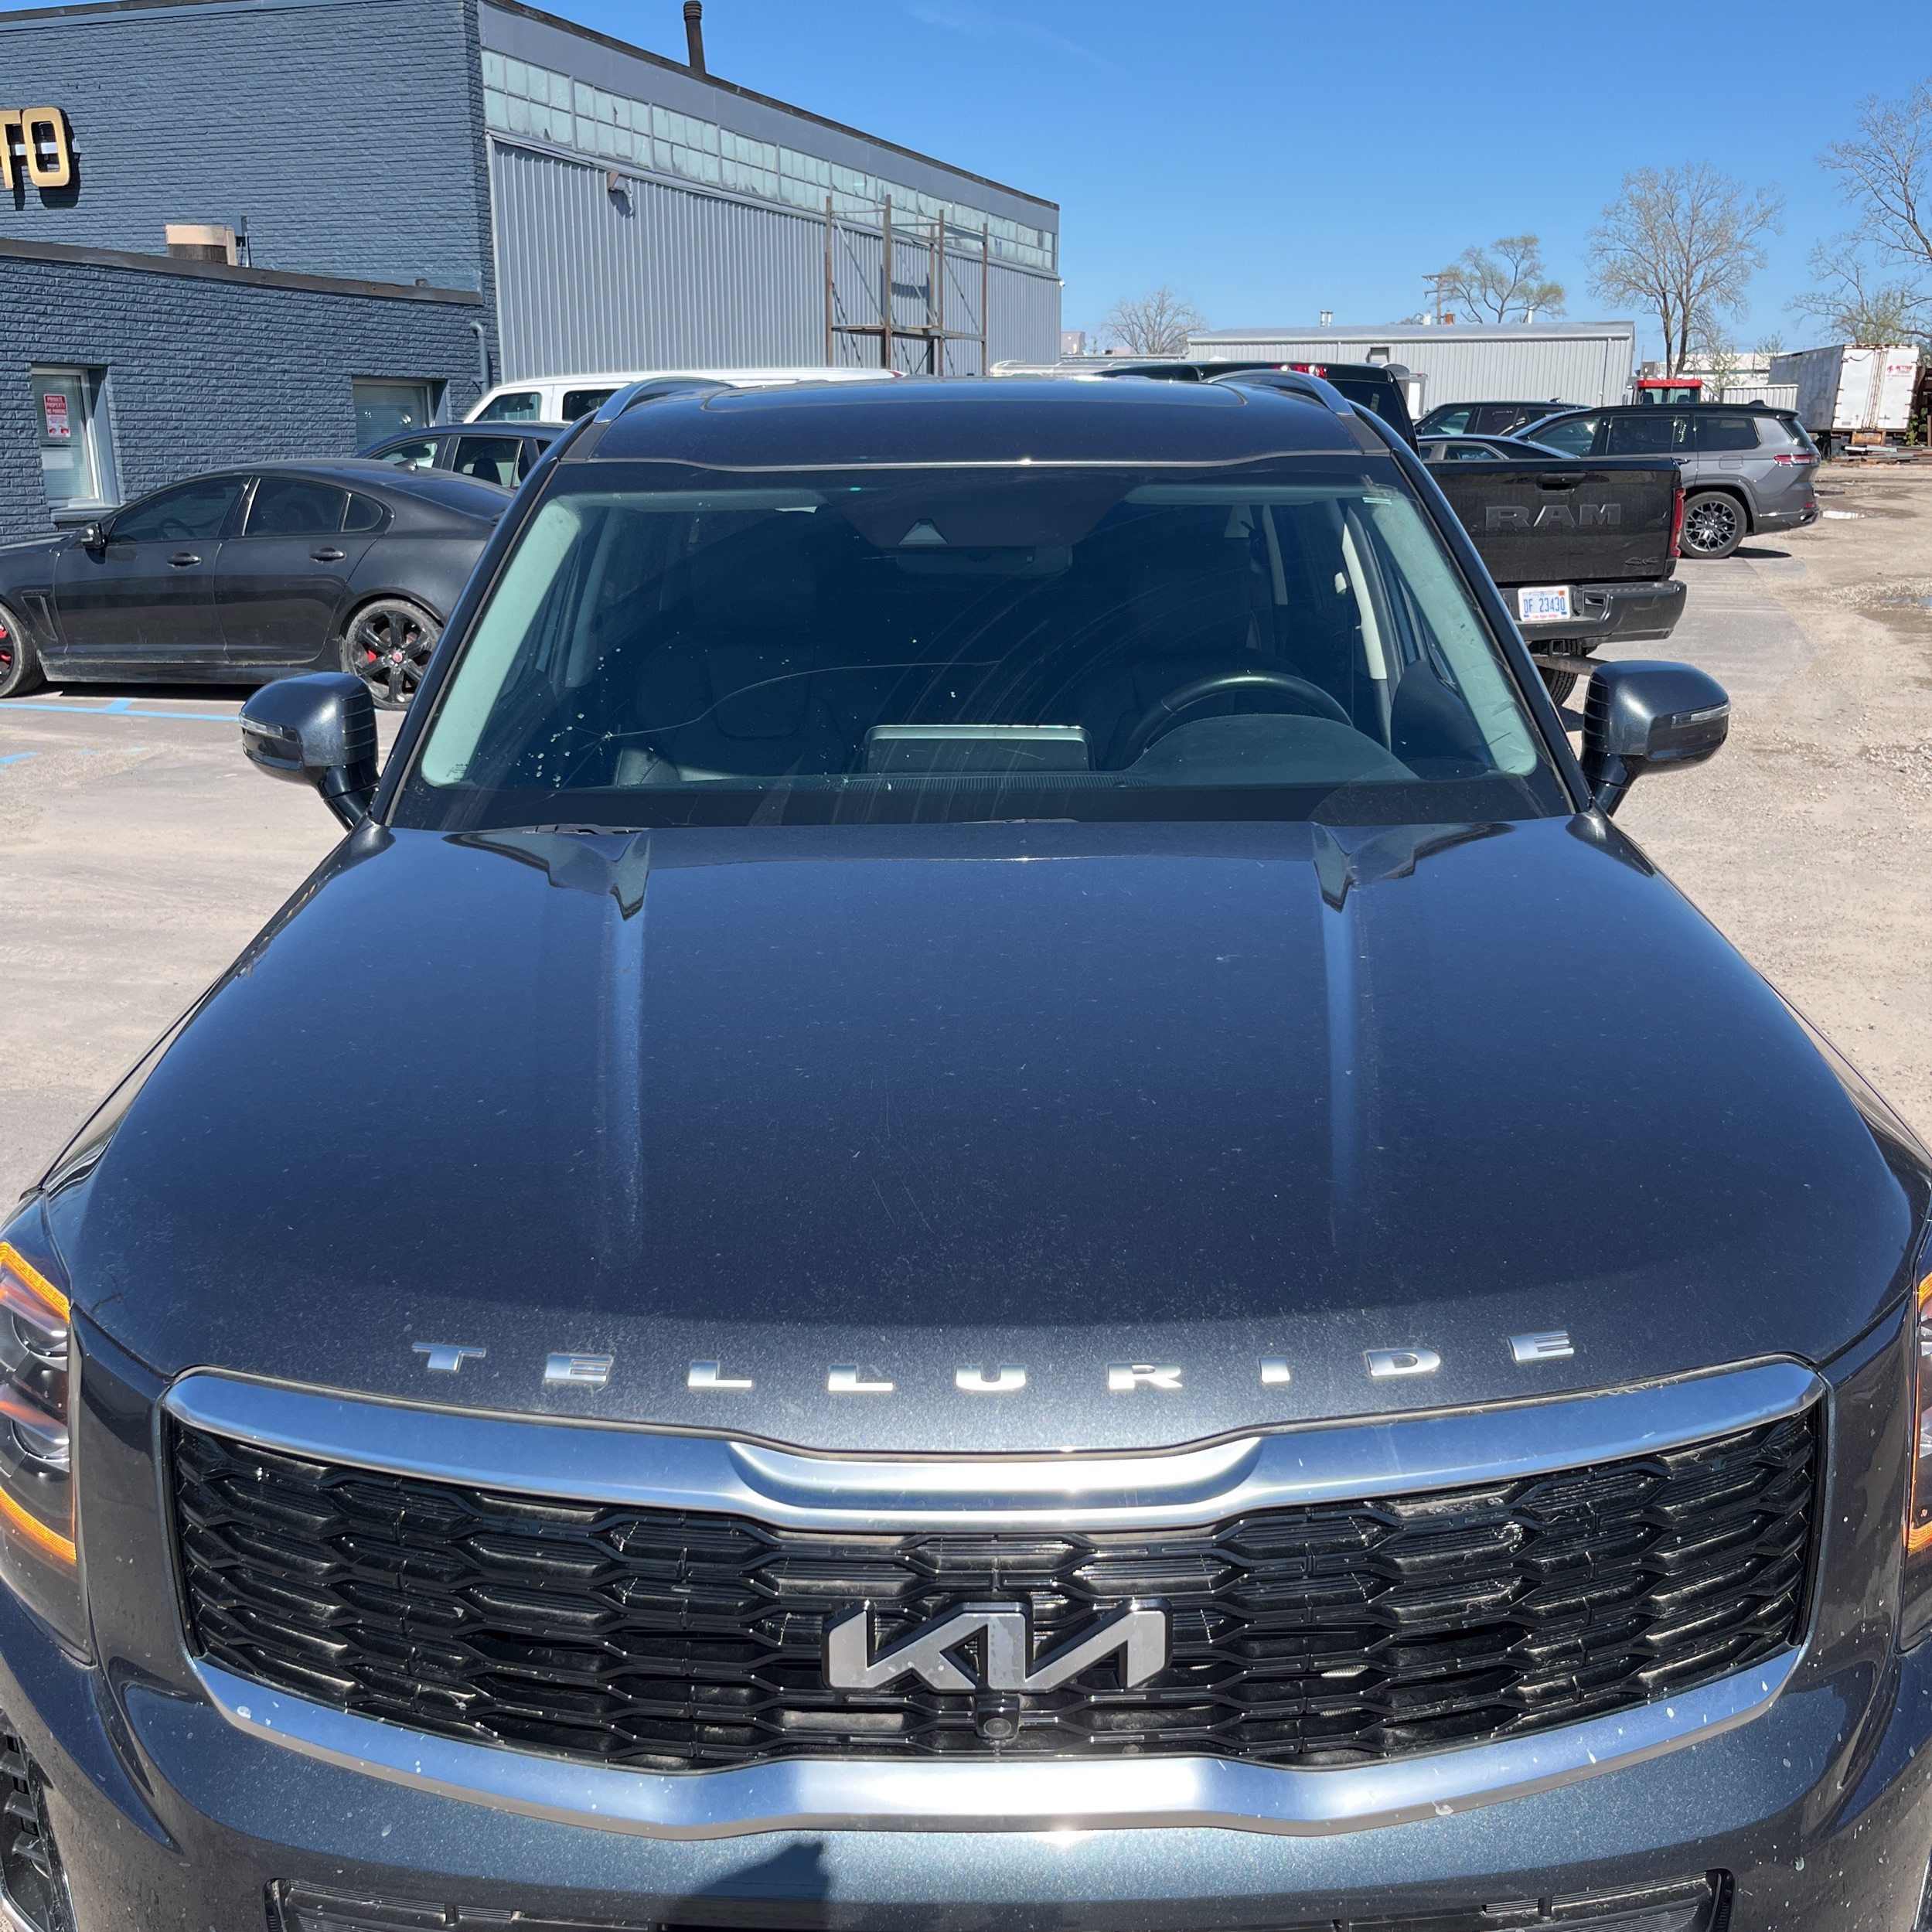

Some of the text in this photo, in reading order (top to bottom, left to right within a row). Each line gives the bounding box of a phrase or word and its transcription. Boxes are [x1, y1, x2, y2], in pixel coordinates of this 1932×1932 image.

[1485, 503, 1621, 528] RAM
[1523, 597, 1566, 613] DF 23430
[411, 1330, 1575, 1390] TELLURIDE
